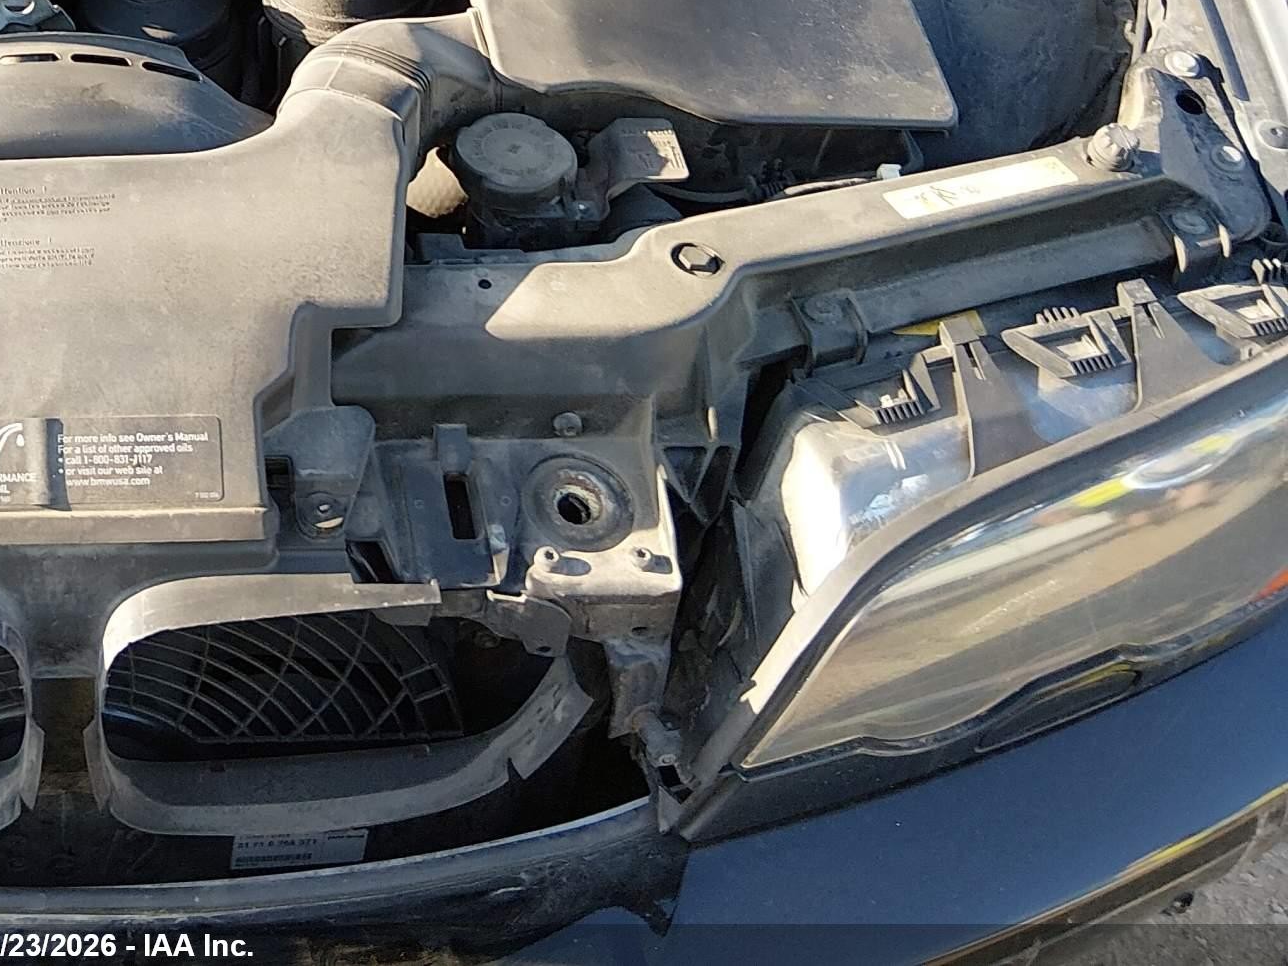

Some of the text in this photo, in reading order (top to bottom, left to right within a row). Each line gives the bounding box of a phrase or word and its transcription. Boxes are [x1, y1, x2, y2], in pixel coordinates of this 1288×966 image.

[57, 431, 209, 443] For more info see Owner's Manual
[57, 444, 73, 454] For
[82, 444, 97, 453] list
[97, 444, 107, 453] of
[108, 444, 133, 453] other
[133, 443, 175, 455] approved
[176, 443, 193, 453] oils
[65, 455, 82, 464] call
[65, 465, 163, 475] or visit our web site at
[65, 477, 151, 486] www.bmwusa.com
